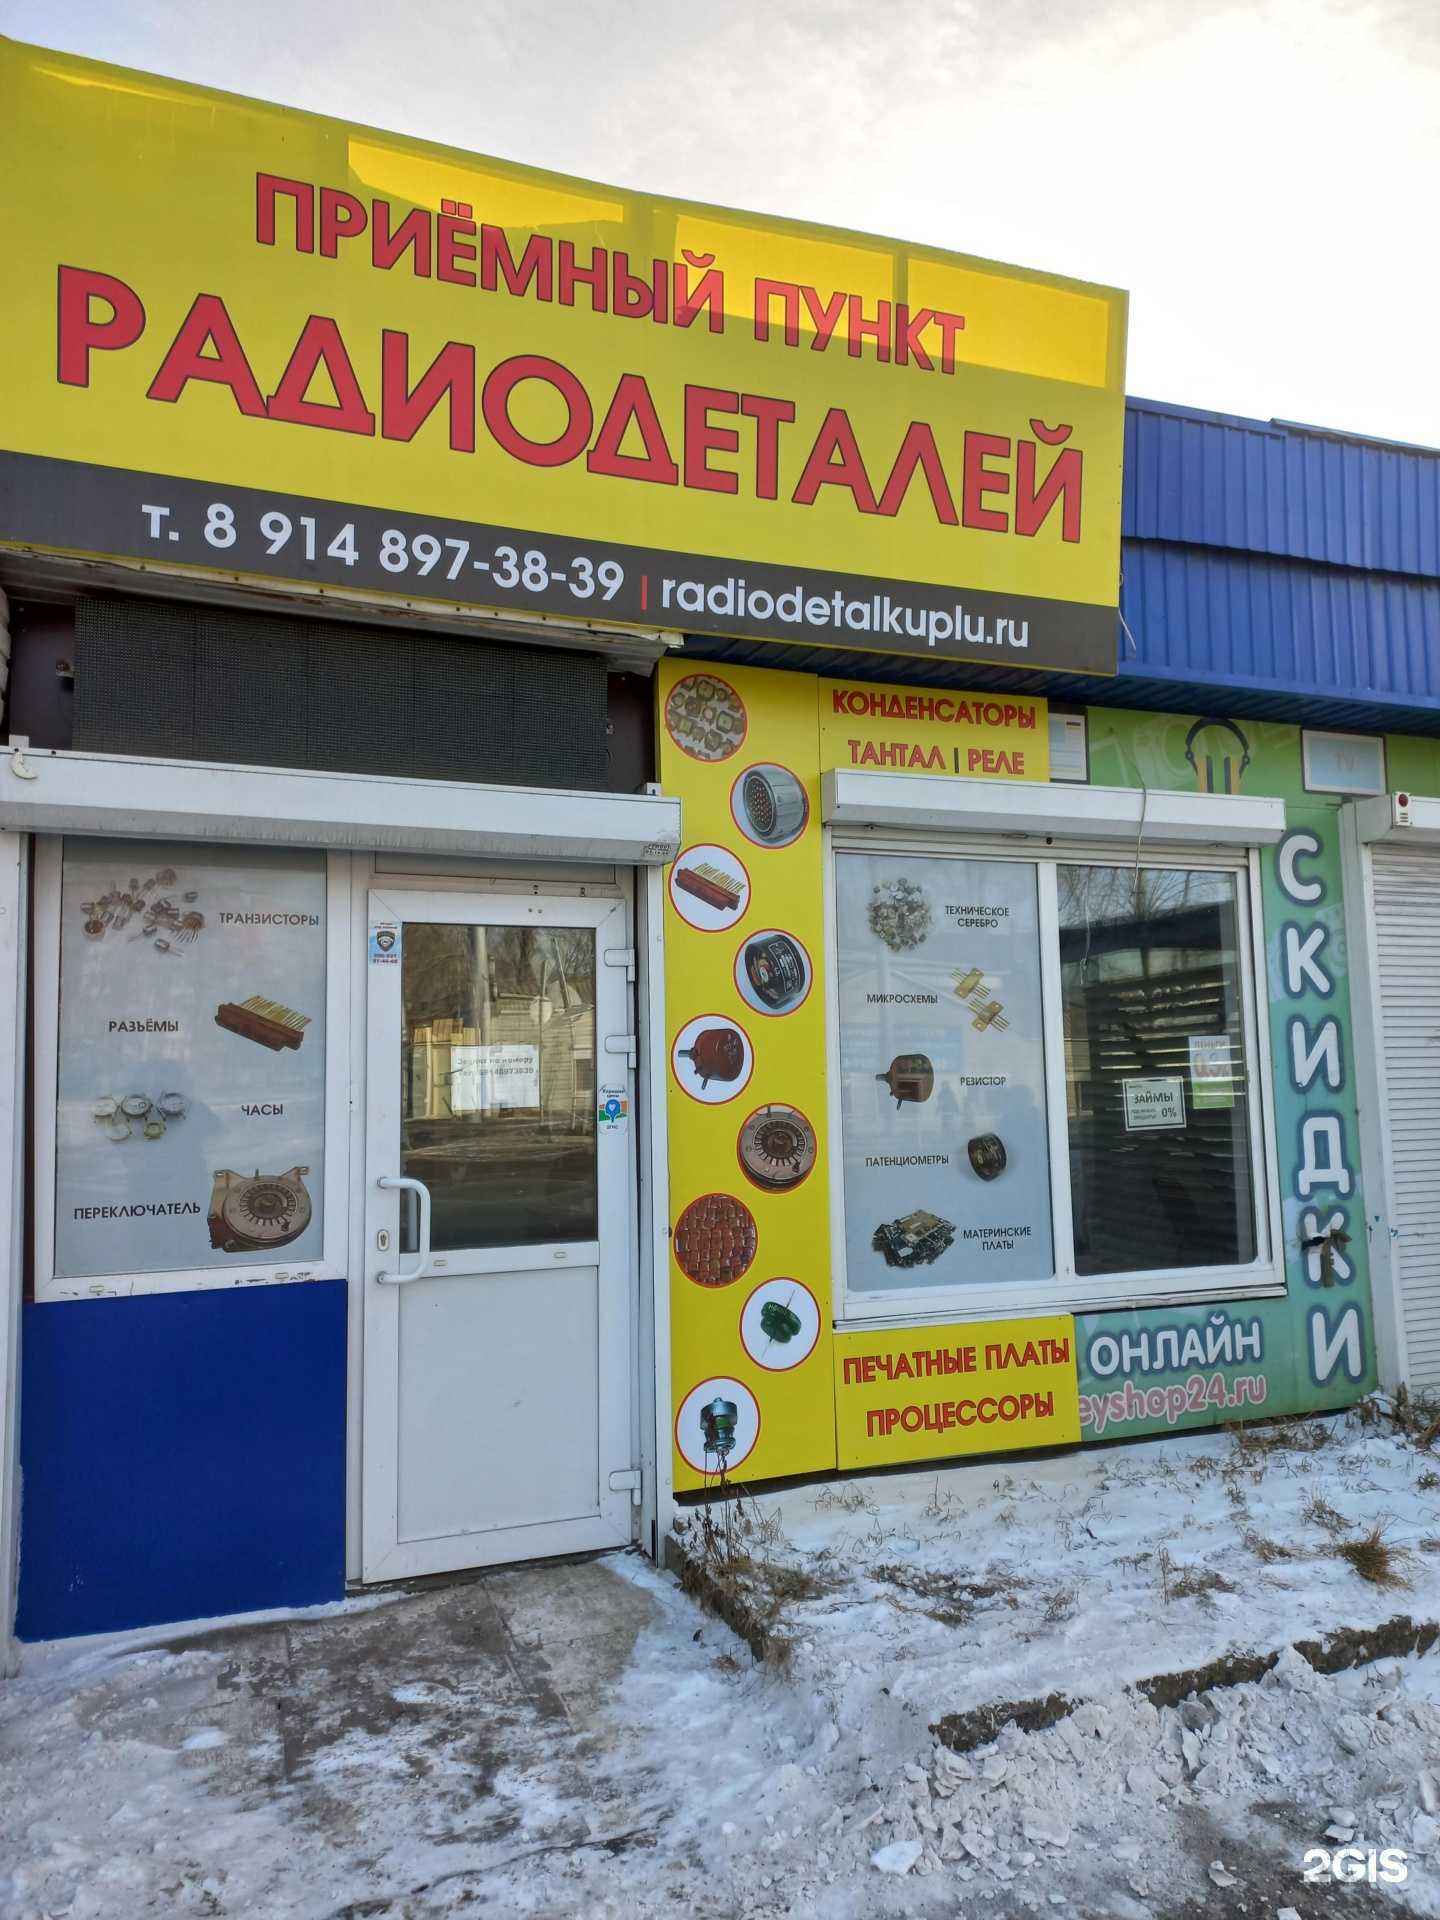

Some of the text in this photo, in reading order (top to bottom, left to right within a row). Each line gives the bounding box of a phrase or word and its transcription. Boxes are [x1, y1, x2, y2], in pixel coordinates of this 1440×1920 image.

[256, 172, 965, 375] ПРИЁМНЫЙ ПУНКТ
[57, 263, 1083, 543] РАДИОДЕТАЛЕЙ
[141, 503, 1030, 648] т. 8 914 897-38-39 radiodetalkuplu.ru
[832, 690, 1036, 729] КОНДЕНСАТОРЫ
[848, 740, 1025, 775] ТАНТАЛ РЕЛЕ
[219, 911, 319, 926] ТРАНЗИСТОРЫ
[945, 905, 1010, 917] ТЕХНИЧЕСКОЕ
[957, 918, 998, 928] СЕРЕБРО
[866, 993, 938, 1005] МИКРОСХЕМЫ
[108, 1017, 179, 1033] РАЗЪЁМЫ
[960, 1076, 1006, 1087] РЕЗИСТОР
[241, 1103, 284, 1116] ЧАСЫ
[1276, 832, 1364, 1385] СКИДКИ
[865, 1155, 949, 1168] ПАТЕНЦИОМЕТРЫ
[73, 1202, 201, 1220] ПЕРЕКЛЮЧАТЕЛЬ
[962, 1226, 1031, 1239] МАТЕРИНСКИЕ
[981, 1239, 1014, 1251] ПЛАТЫ
[1089, 1313, 1262, 1374] ОНЛАЙН
[843, 1337, 1070, 1384] ПЕЧАТНЫЕ ПЛАТЫ
[866, 1392, 1054, 1437] ПРОЦЕССОРЫ
